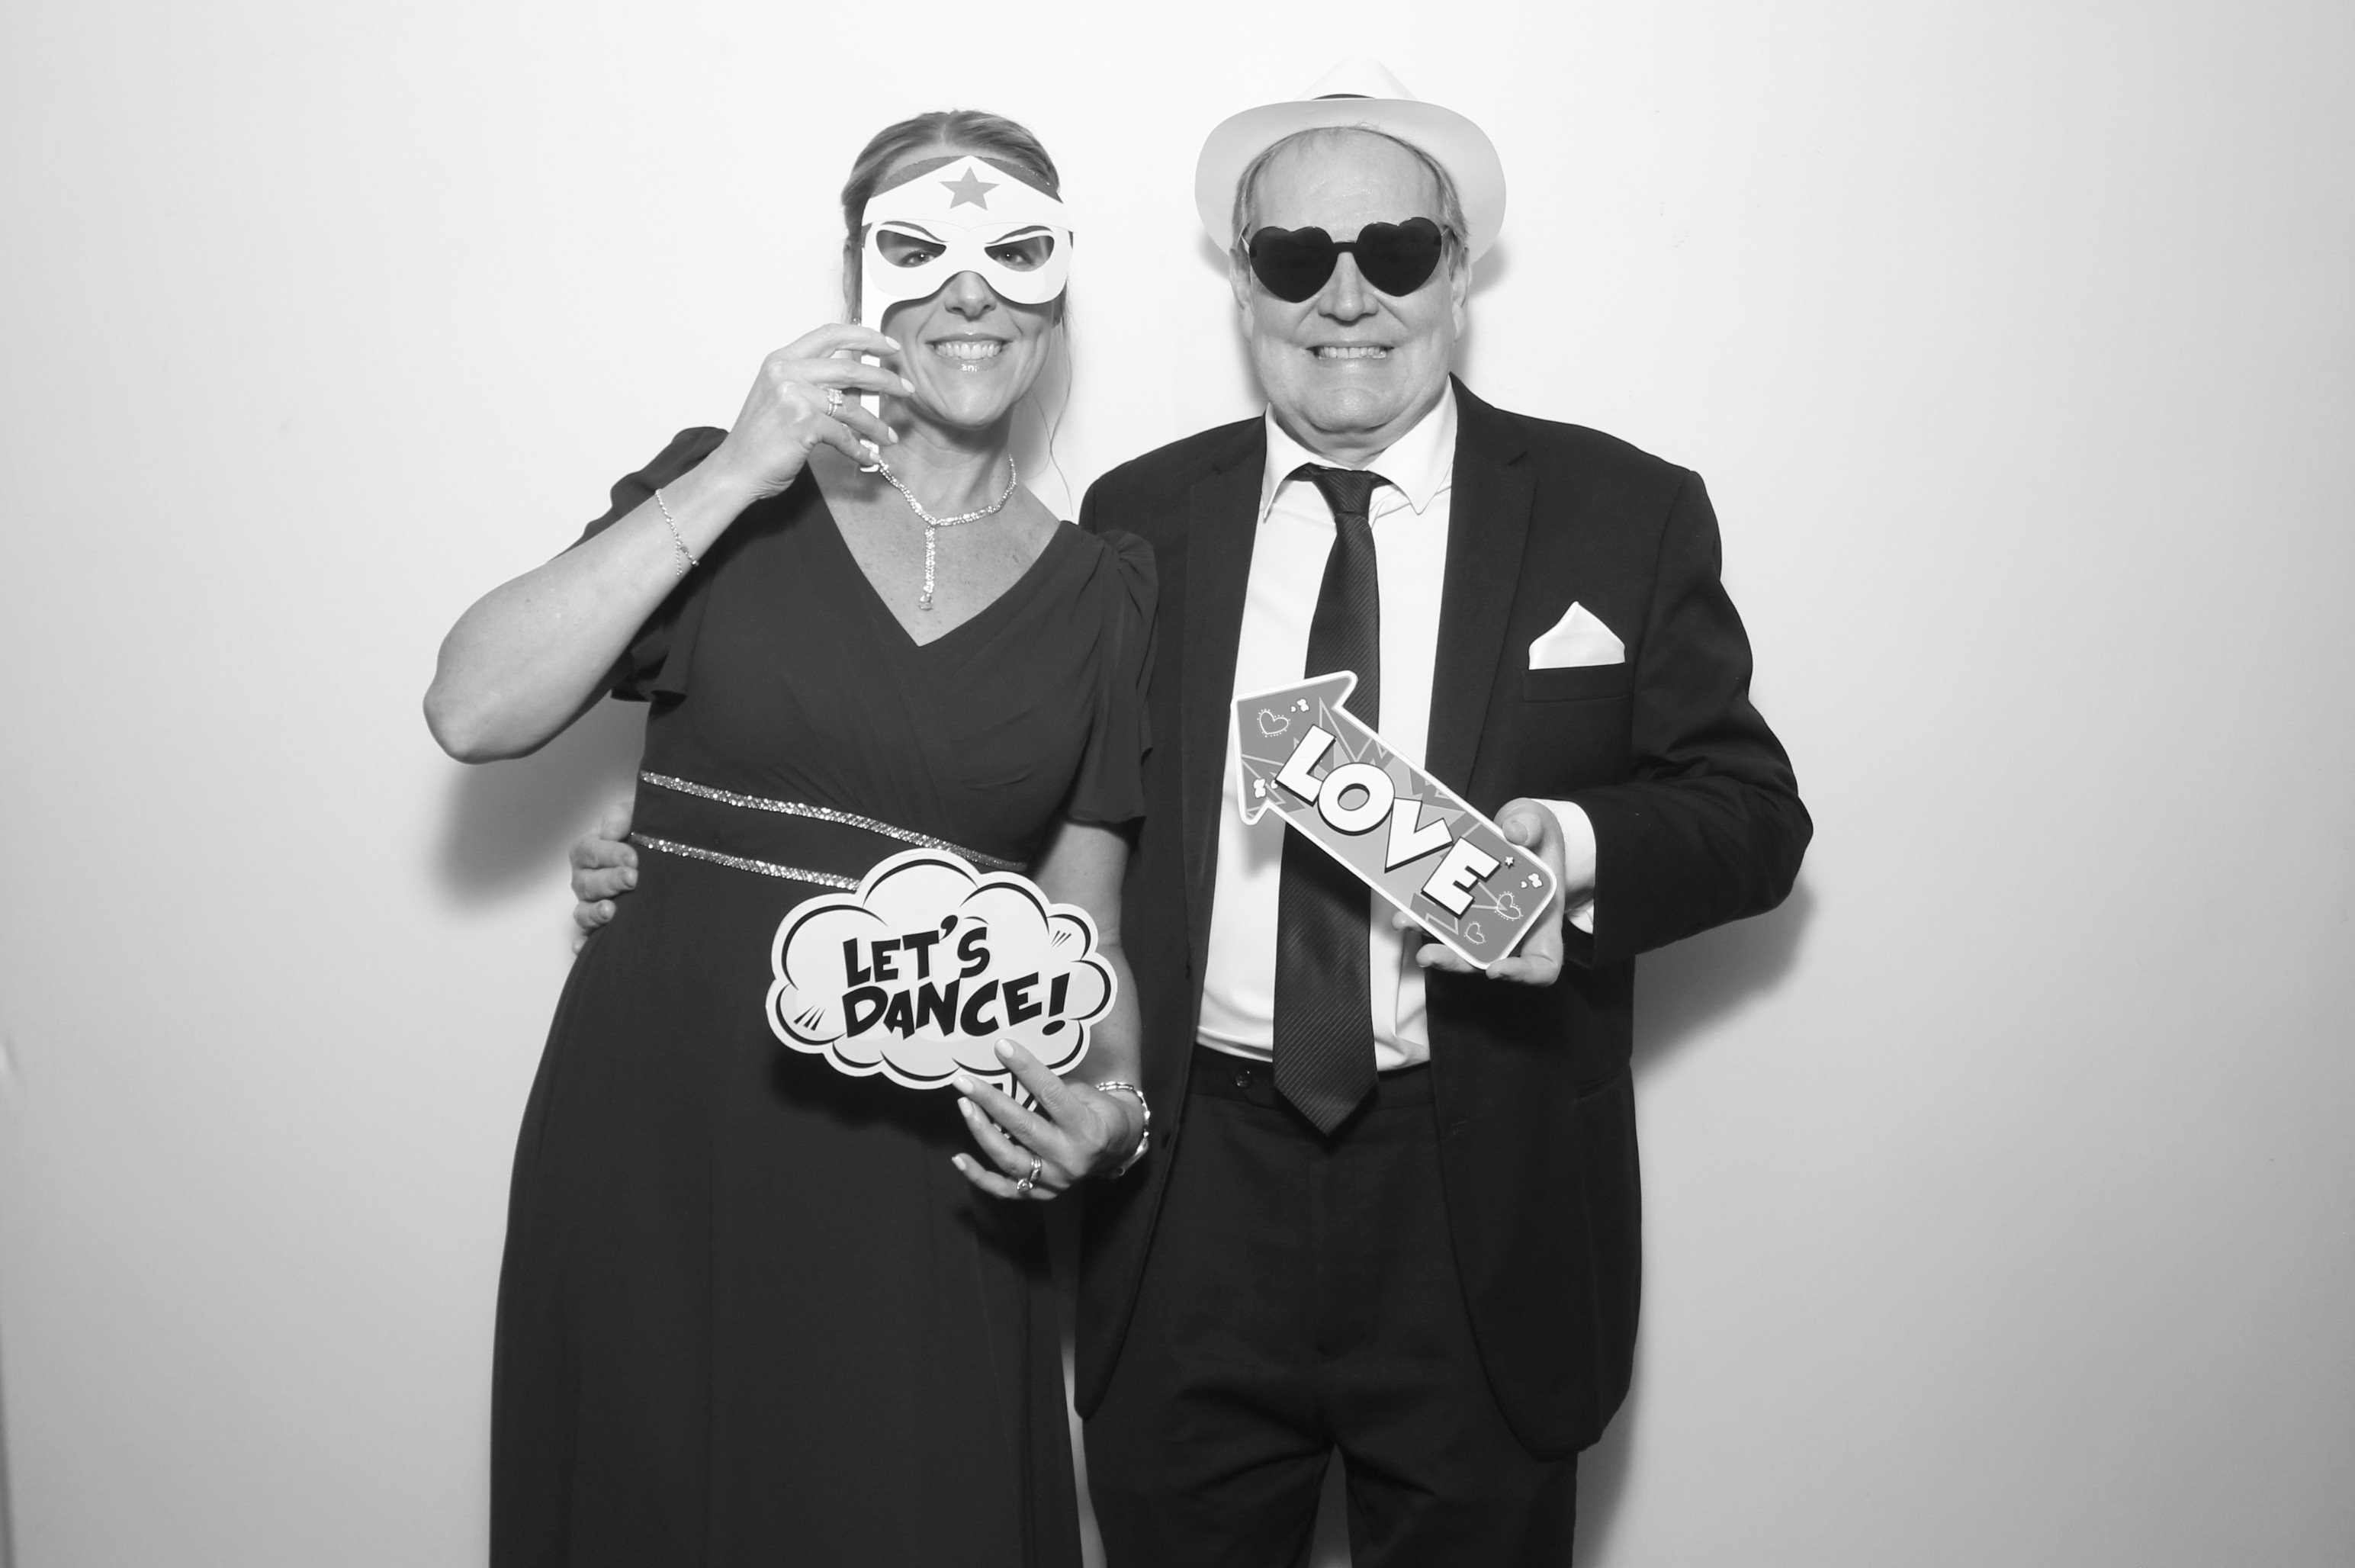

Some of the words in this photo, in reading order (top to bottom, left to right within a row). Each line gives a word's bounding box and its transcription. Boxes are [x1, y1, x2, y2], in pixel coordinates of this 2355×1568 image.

[1274, 724, 1502, 920] LOVE
[843, 915, 990, 988] LET'S
[842, 972, 1070, 1039] DANCE!
